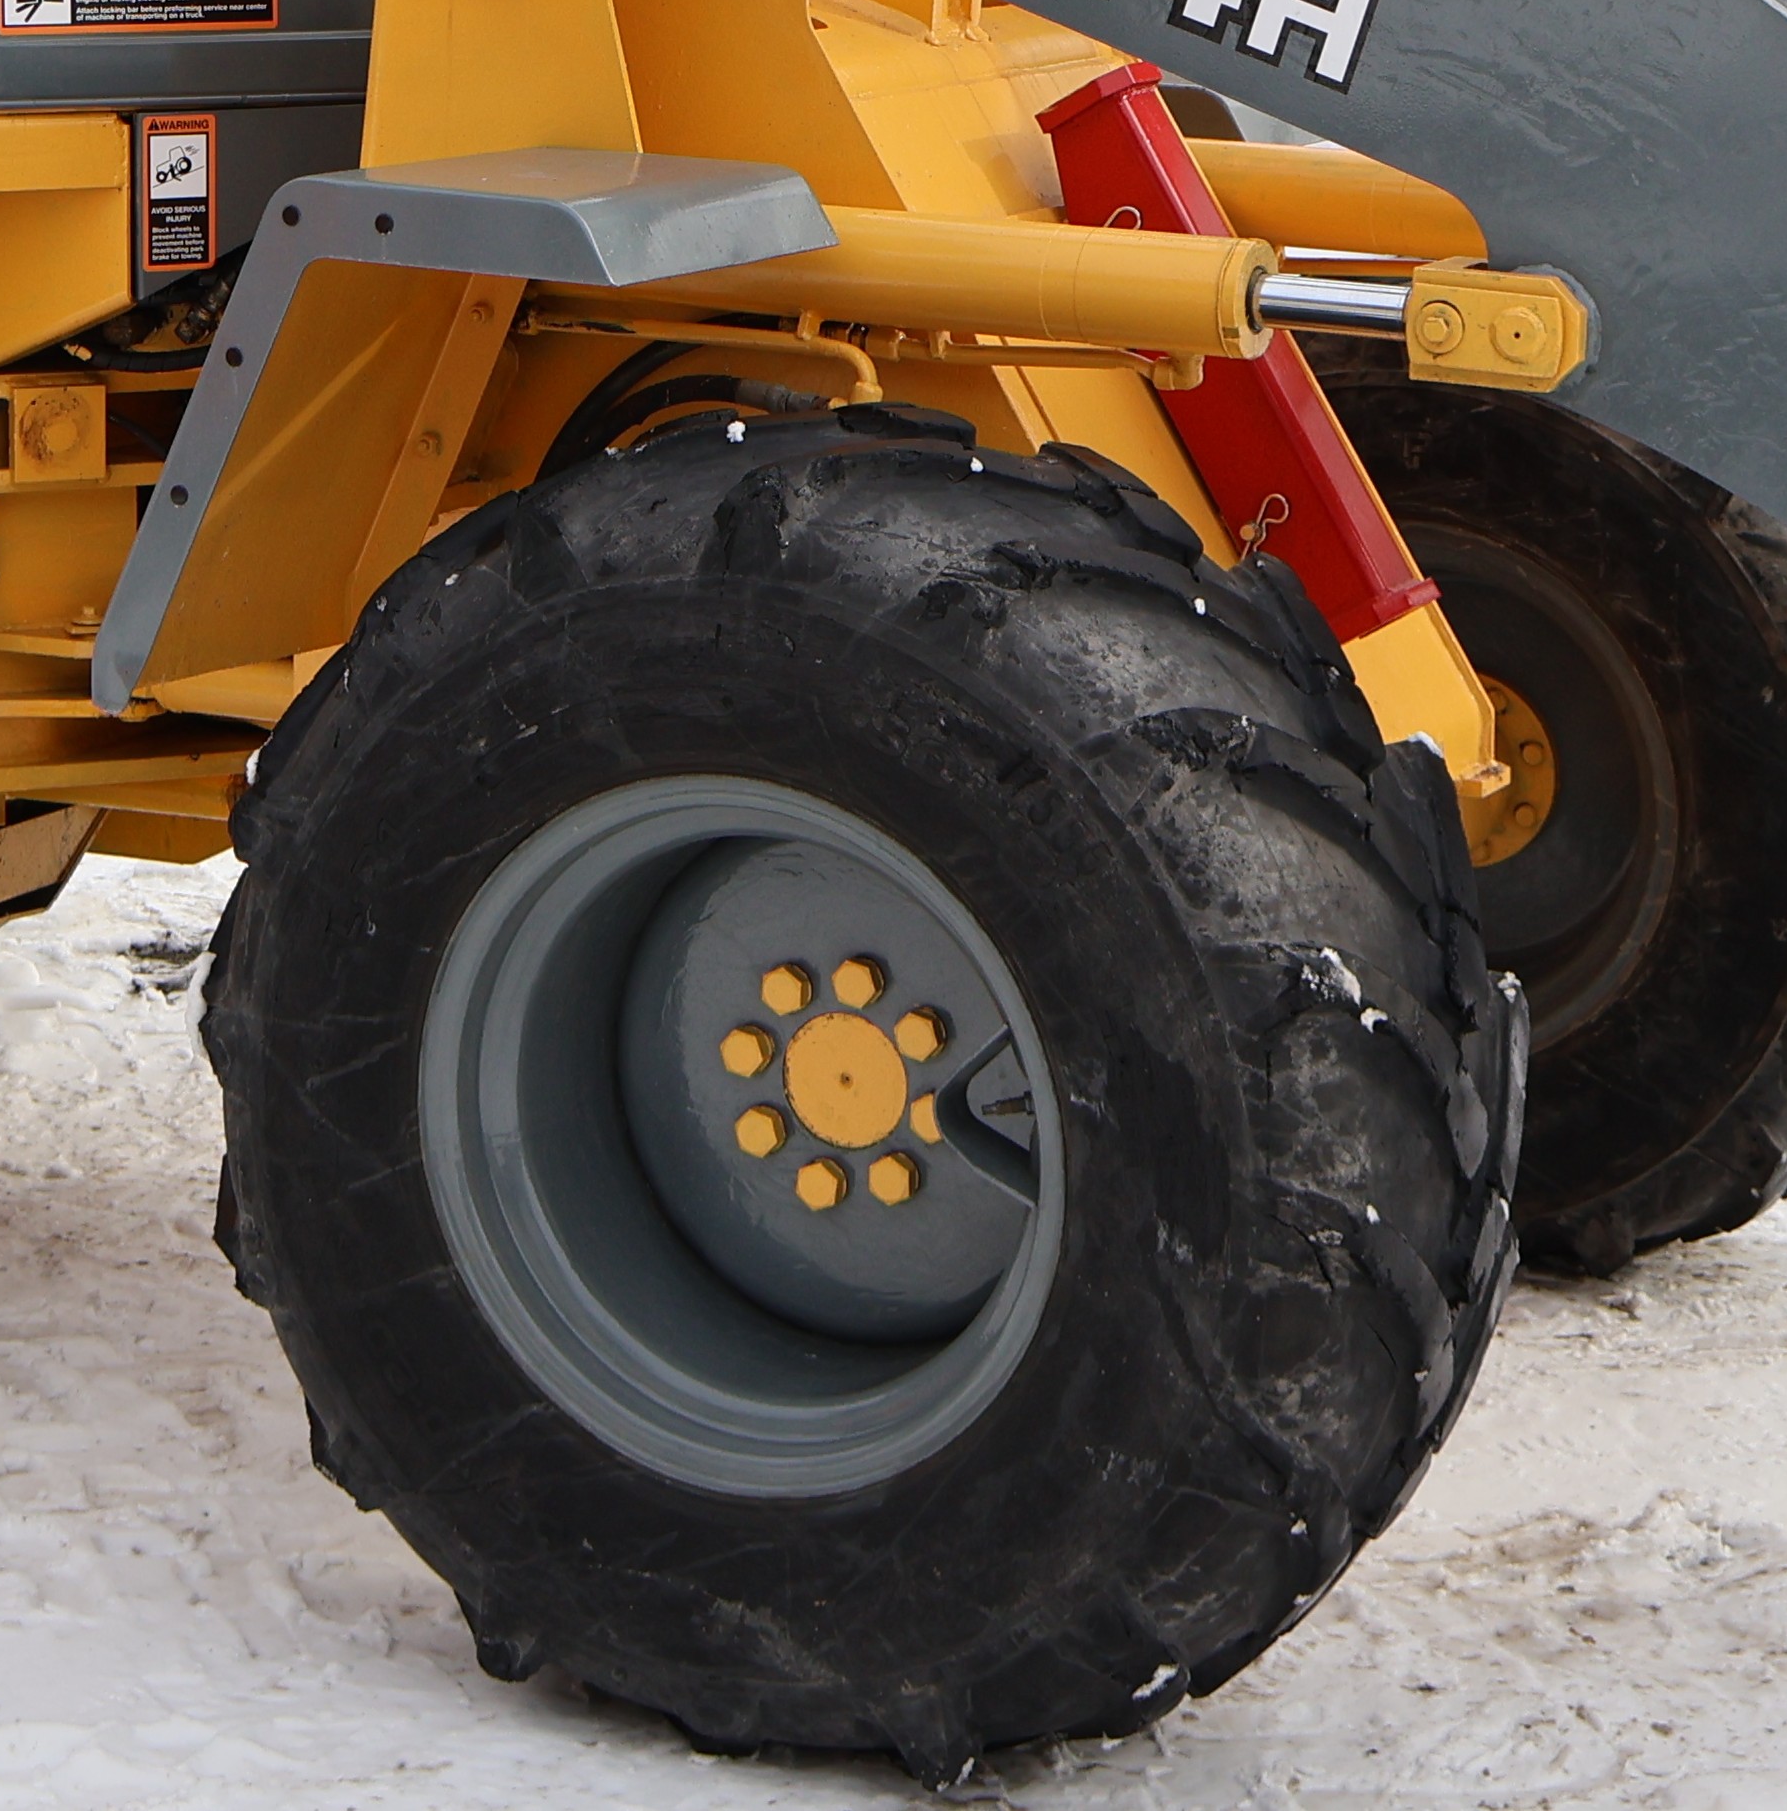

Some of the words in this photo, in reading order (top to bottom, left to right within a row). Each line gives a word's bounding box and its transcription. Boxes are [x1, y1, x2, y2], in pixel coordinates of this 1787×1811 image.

[100, 6, 126, 14] locking
[159, 119, 209, 129] WARNING
[151, 206, 173, 215] AVOID
[174, 205, 206, 213] SERIOUS
[166, 214, 192, 223] INJURY
[152, 233, 175, 241] prevent
[181, 252, 203, 260] towing.
